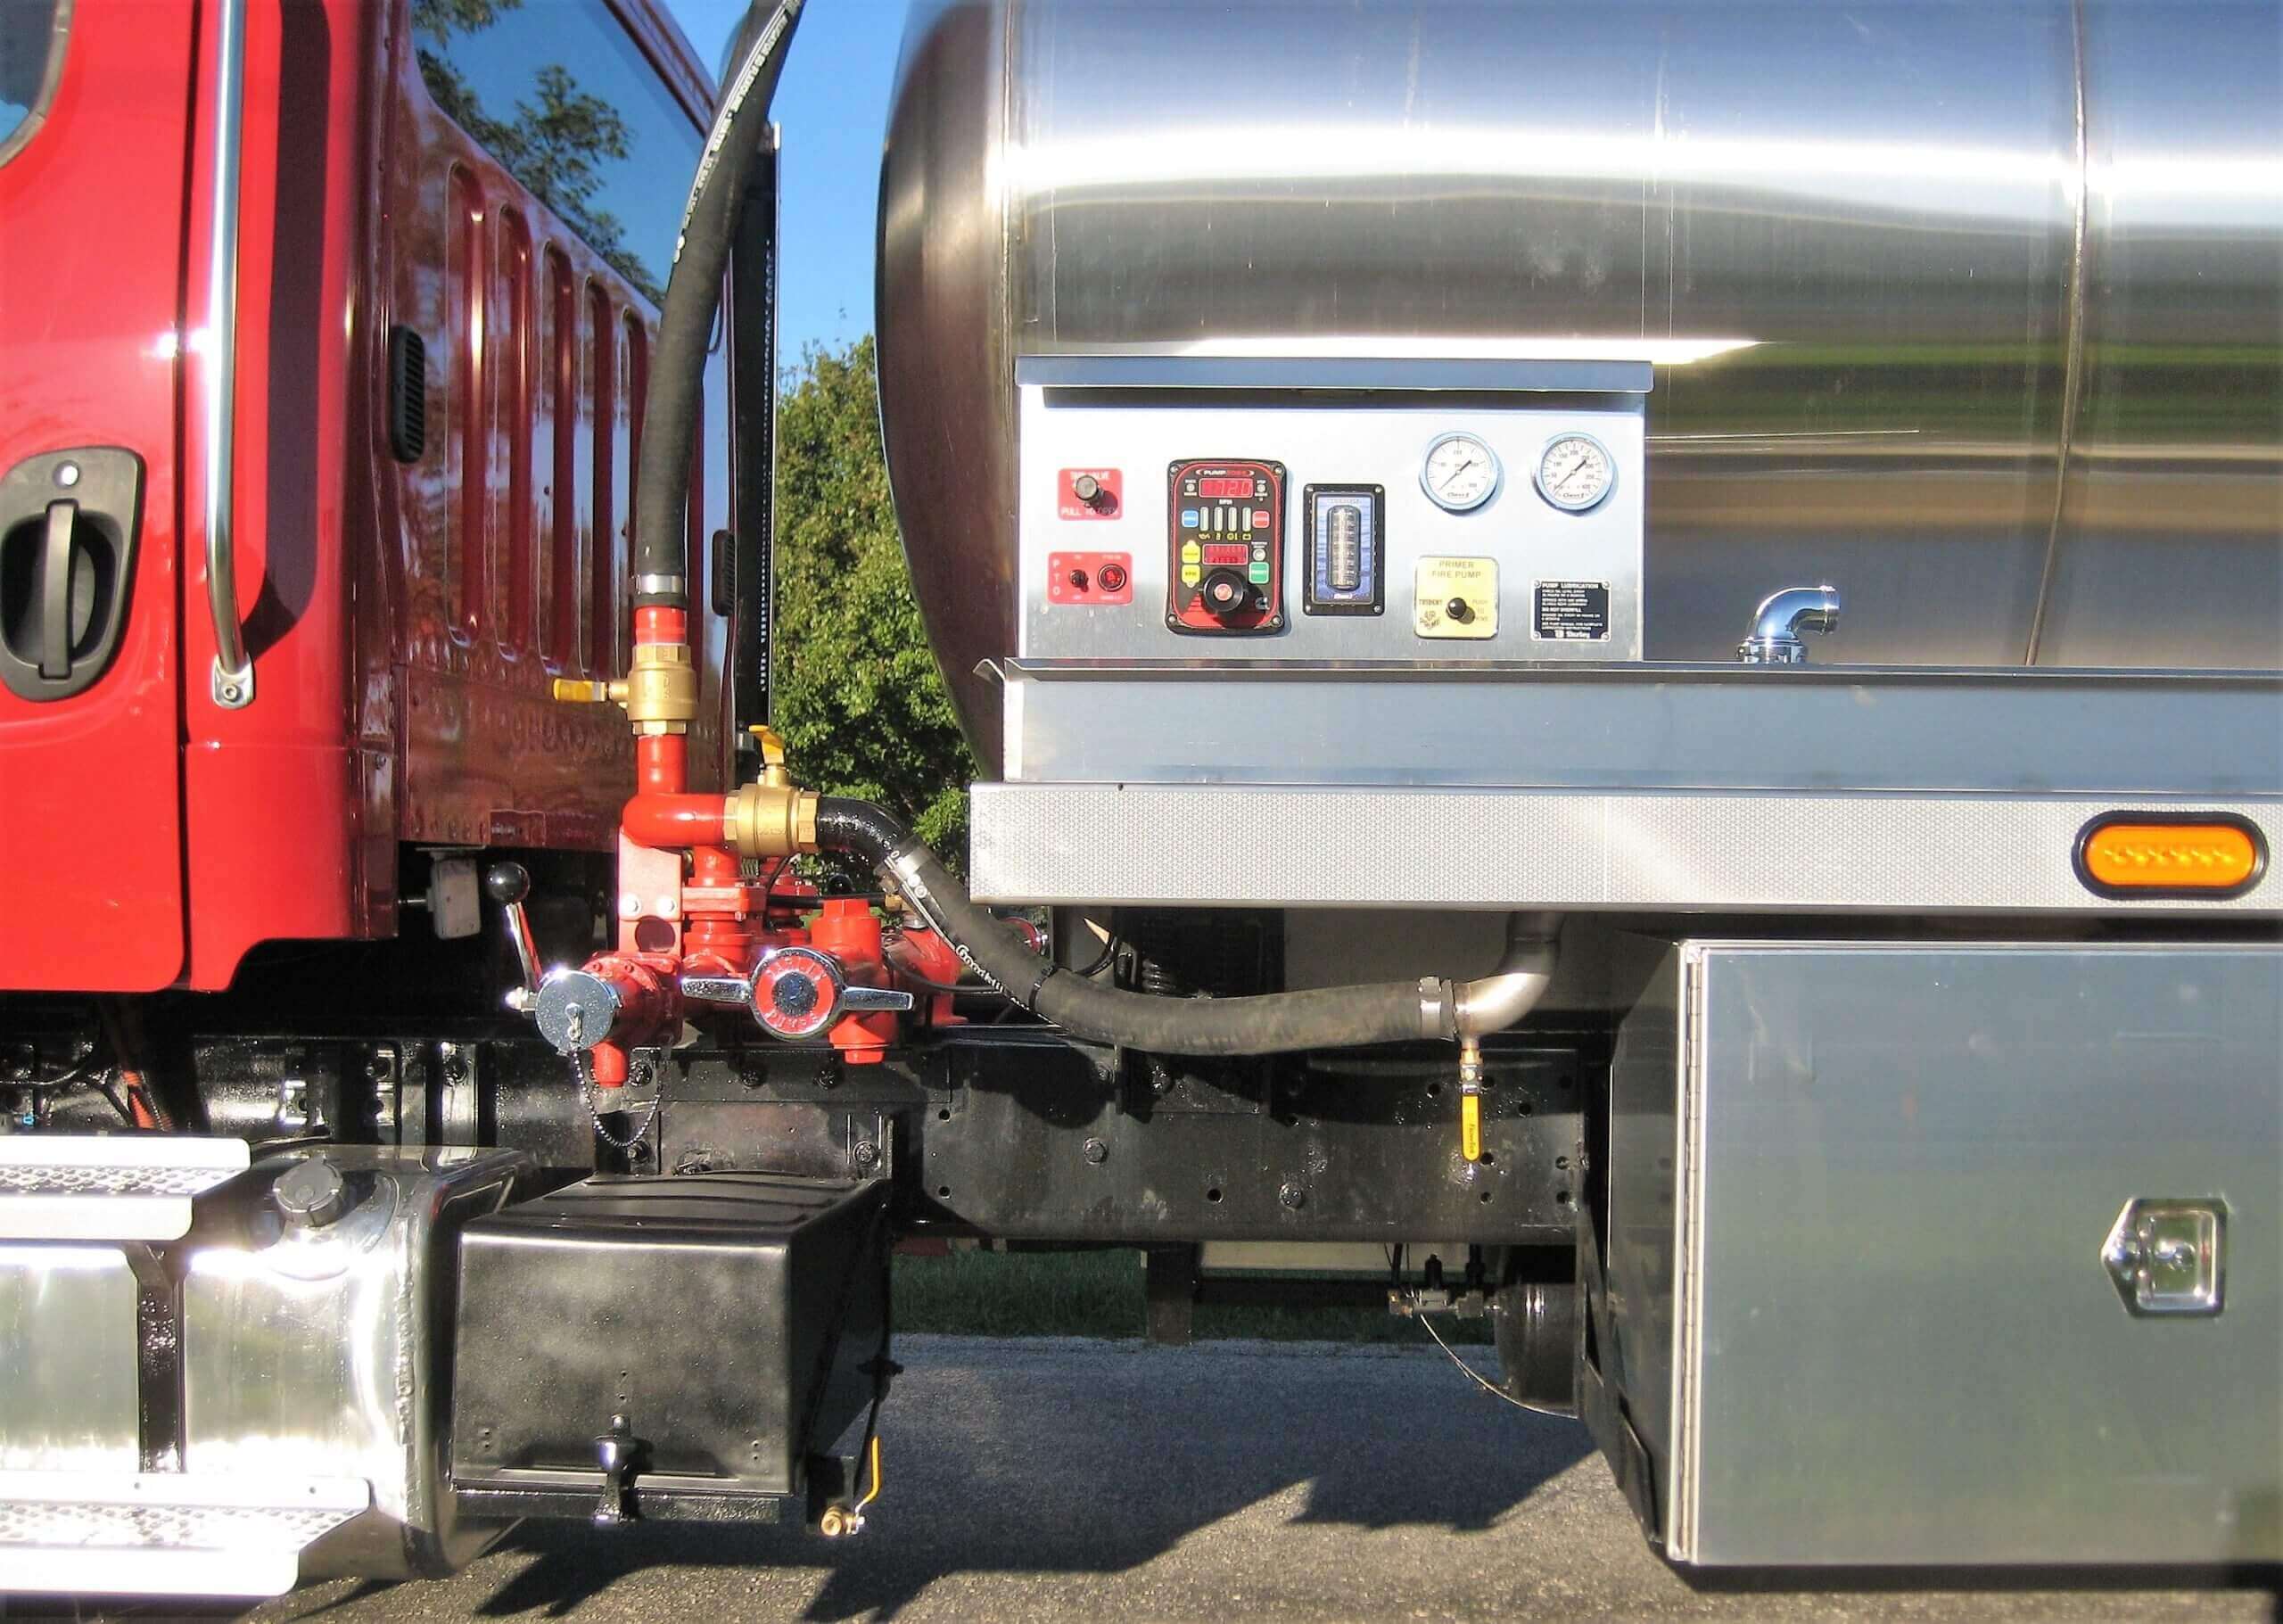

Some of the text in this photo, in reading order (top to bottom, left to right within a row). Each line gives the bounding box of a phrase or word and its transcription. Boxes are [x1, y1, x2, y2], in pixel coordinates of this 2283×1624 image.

[1438, 560, 1475, 569] PRIMER
[1430, 570, 1482, 579] FIRE PUMP
